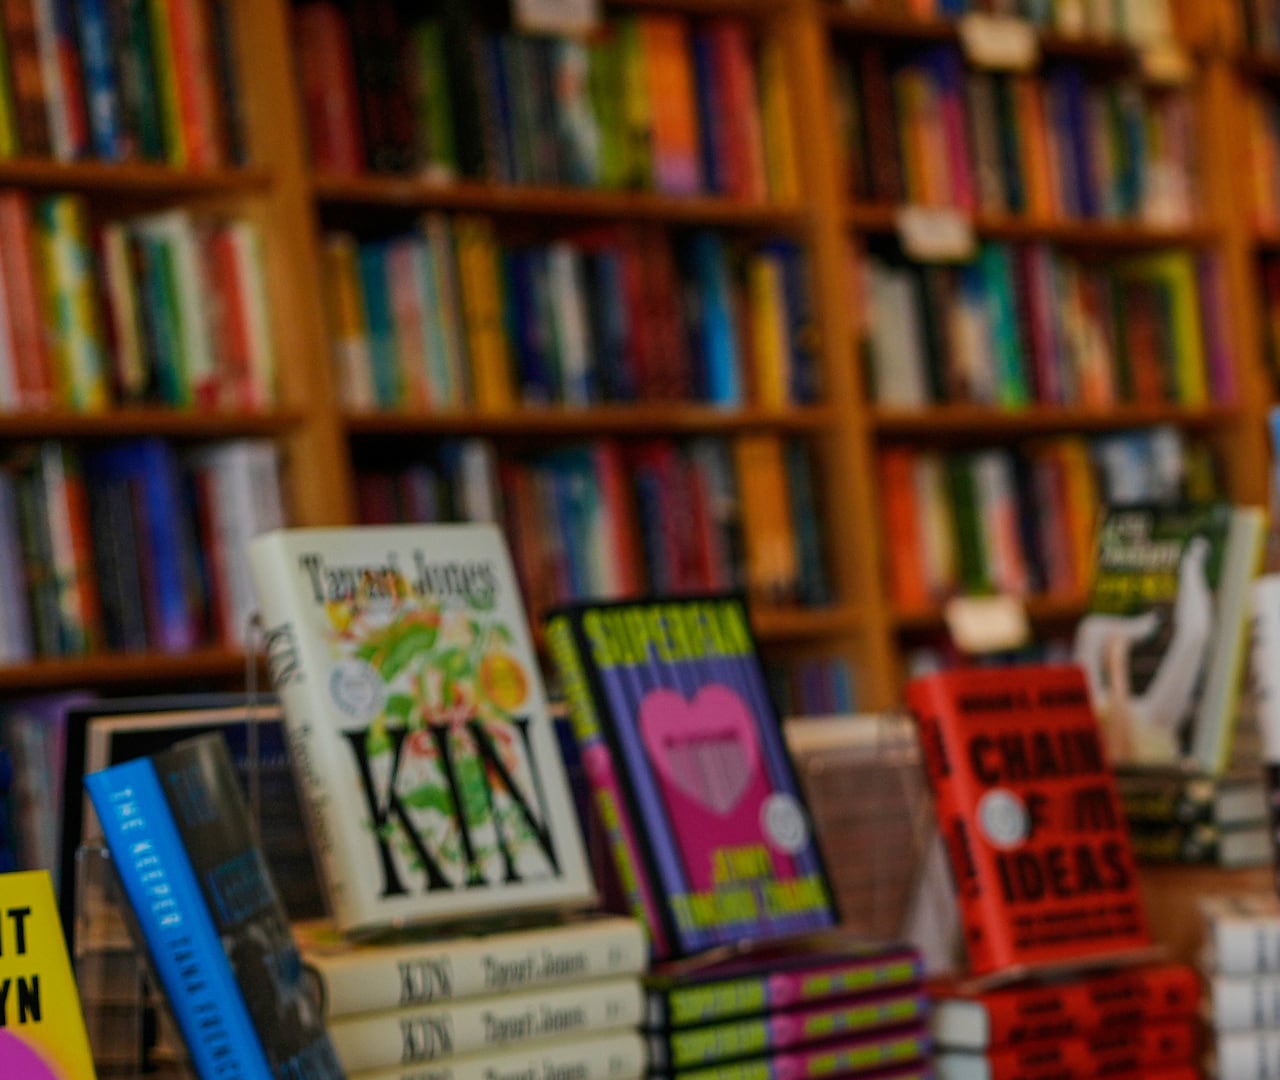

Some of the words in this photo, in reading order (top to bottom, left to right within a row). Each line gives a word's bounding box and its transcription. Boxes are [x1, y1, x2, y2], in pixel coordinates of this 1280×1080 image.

[413, 548, 497, 597] Jones
[968, 728, 1106, 785] CHAIN
[340, 717, 564, 897] KIN
[111, 787, 147, 832] THE
[131, 839, 183, 928] KEEPER
[168, 936, 207, 994] TANA
[995, 842, 1131, 906] IDEAS
